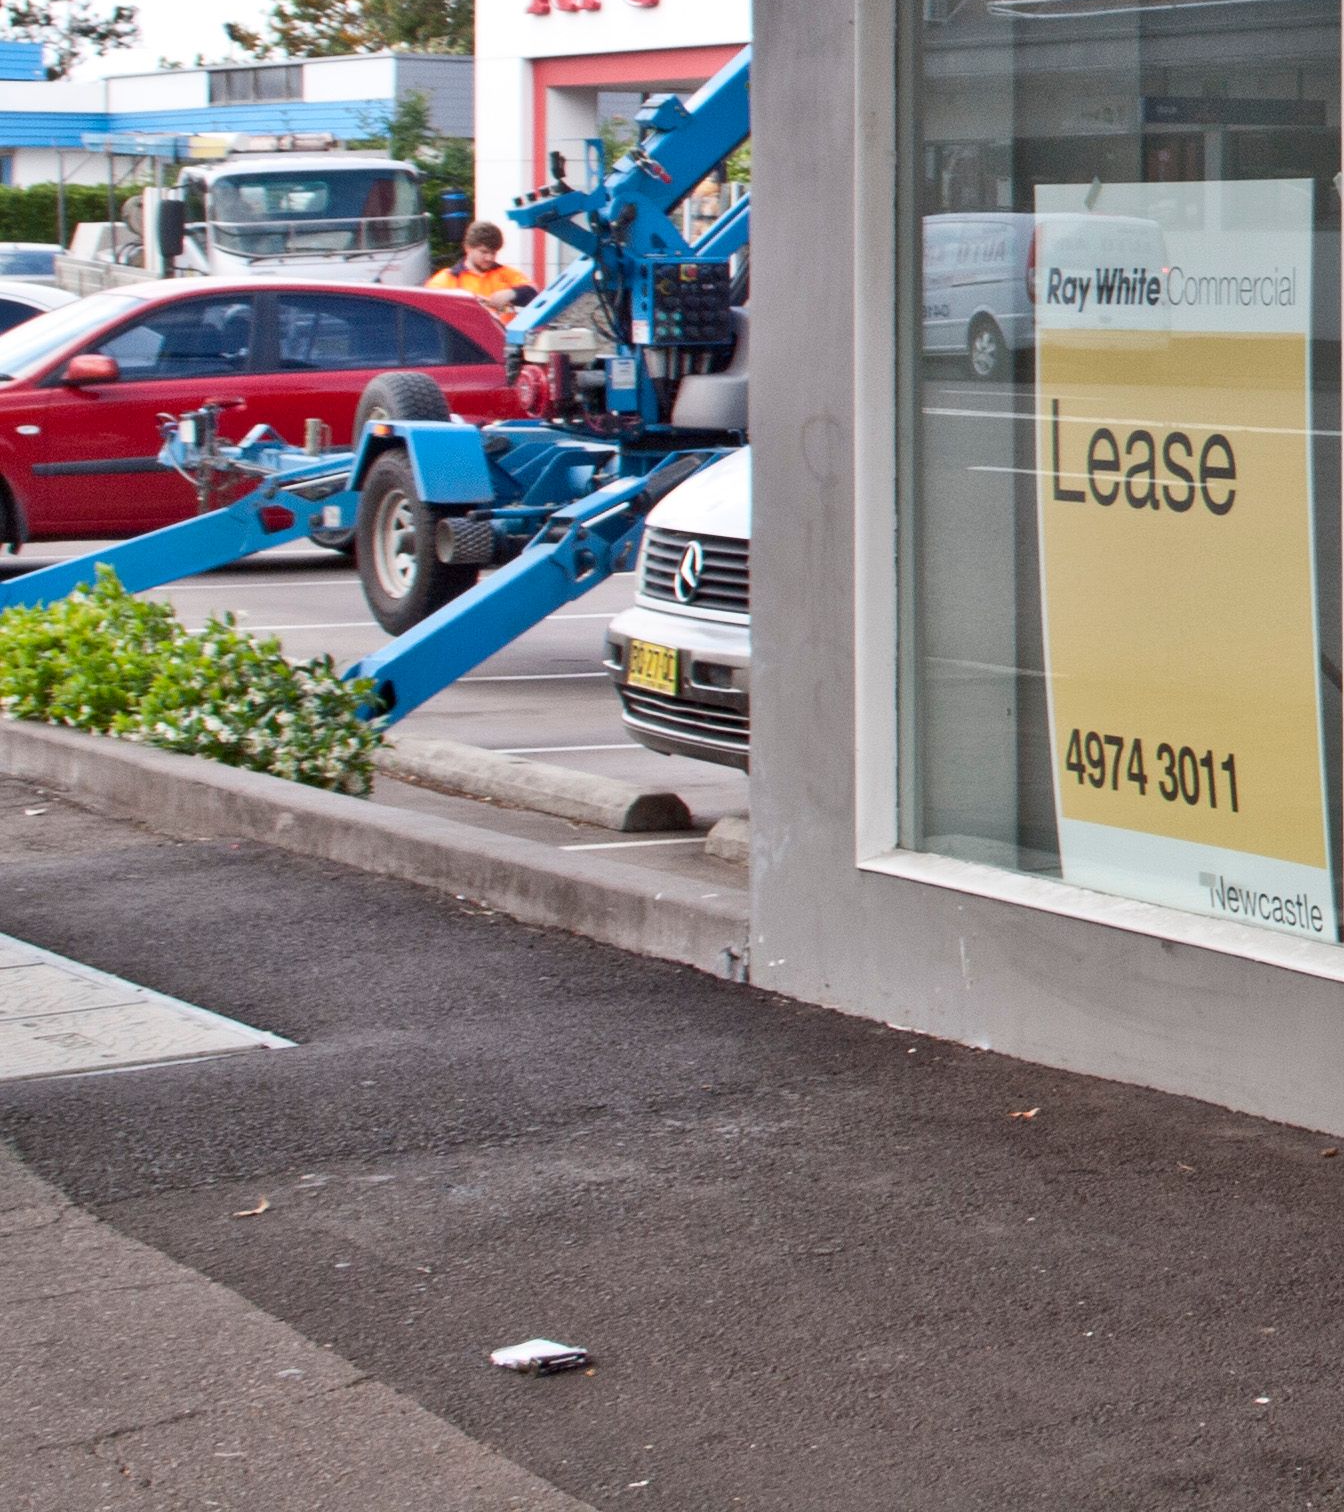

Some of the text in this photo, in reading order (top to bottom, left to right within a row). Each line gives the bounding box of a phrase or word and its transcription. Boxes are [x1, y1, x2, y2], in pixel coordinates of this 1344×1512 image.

[1046, 267, 1091, 312] Ray
[1167, 266, 1297, 306] Commercial
[1051, 398, 1237, 516] Lease
[1065, 728, 1239, 813] 4974 3011
[1209, 875, 1323, 932] Newcastle
